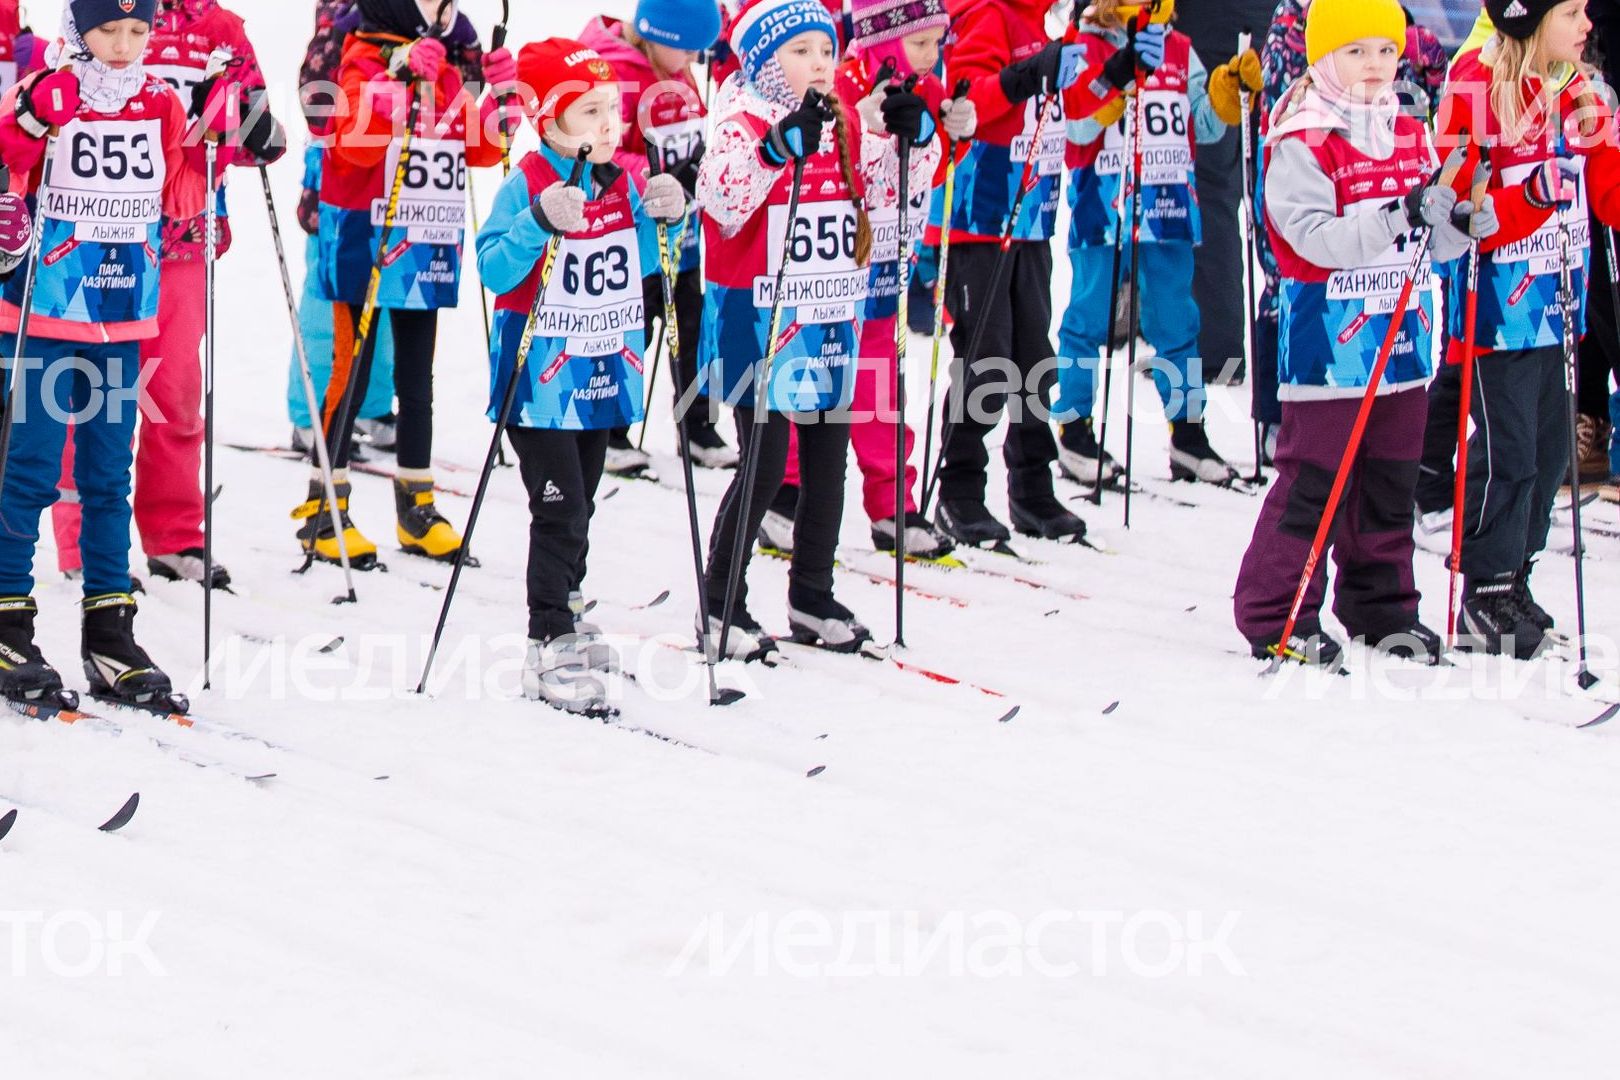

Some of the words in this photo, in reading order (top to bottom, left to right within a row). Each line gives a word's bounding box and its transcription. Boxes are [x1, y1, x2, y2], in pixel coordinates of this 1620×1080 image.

[71, 132, 155, 180] 653
[92, 225, 135, 239] ЛЫЖНЯ
[99, 263, 124, 276] ПАРК
[562, 245, 628, 296] 663
[80, 273, 136, 288] ЛАЗУТИНОЙ
[812, 304, 846, 320] ЛЫЖНЯ
[821, 342, 843, 355] ПАРК
[589, 375, 611, 388] ПАРК
